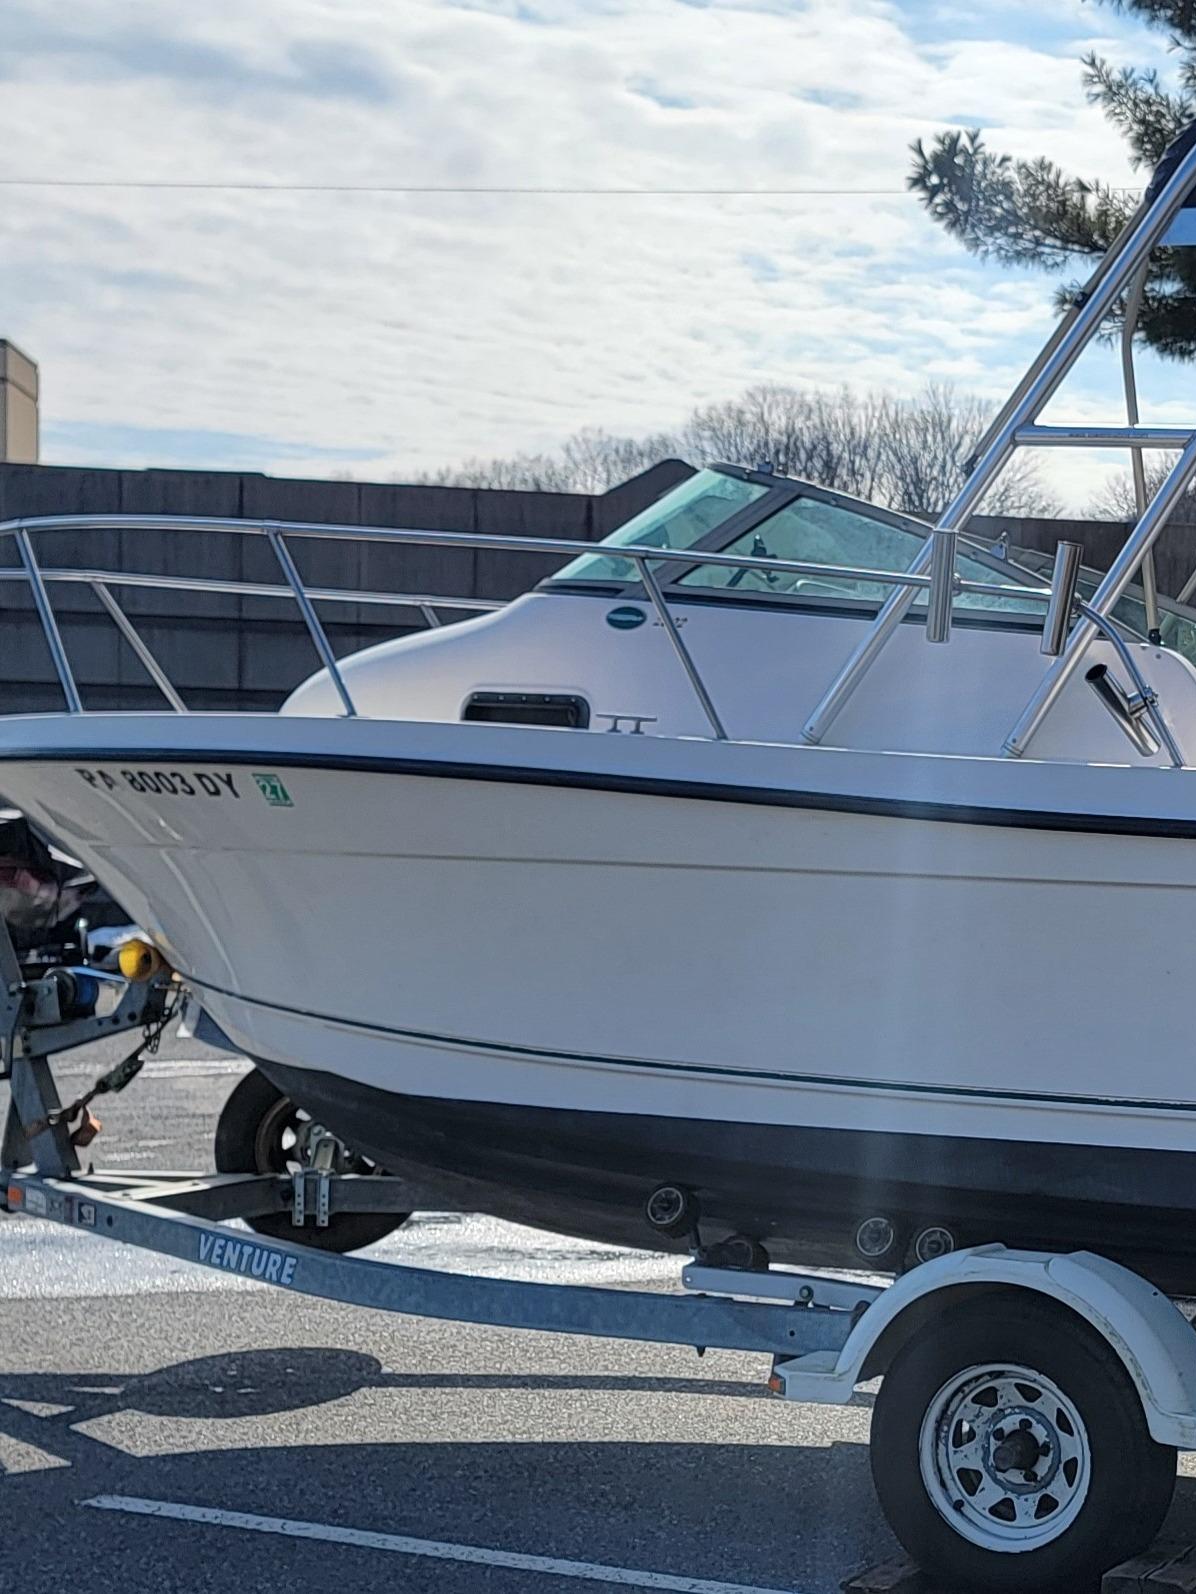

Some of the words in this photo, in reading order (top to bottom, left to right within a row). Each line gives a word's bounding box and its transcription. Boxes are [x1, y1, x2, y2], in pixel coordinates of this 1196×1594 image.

[121, 770, 195, 796] 8003
[193, 773, 240, 798] DY
[257, 780, 286, 801] 27
[200, 1233, 297, 1284] VENTURE
